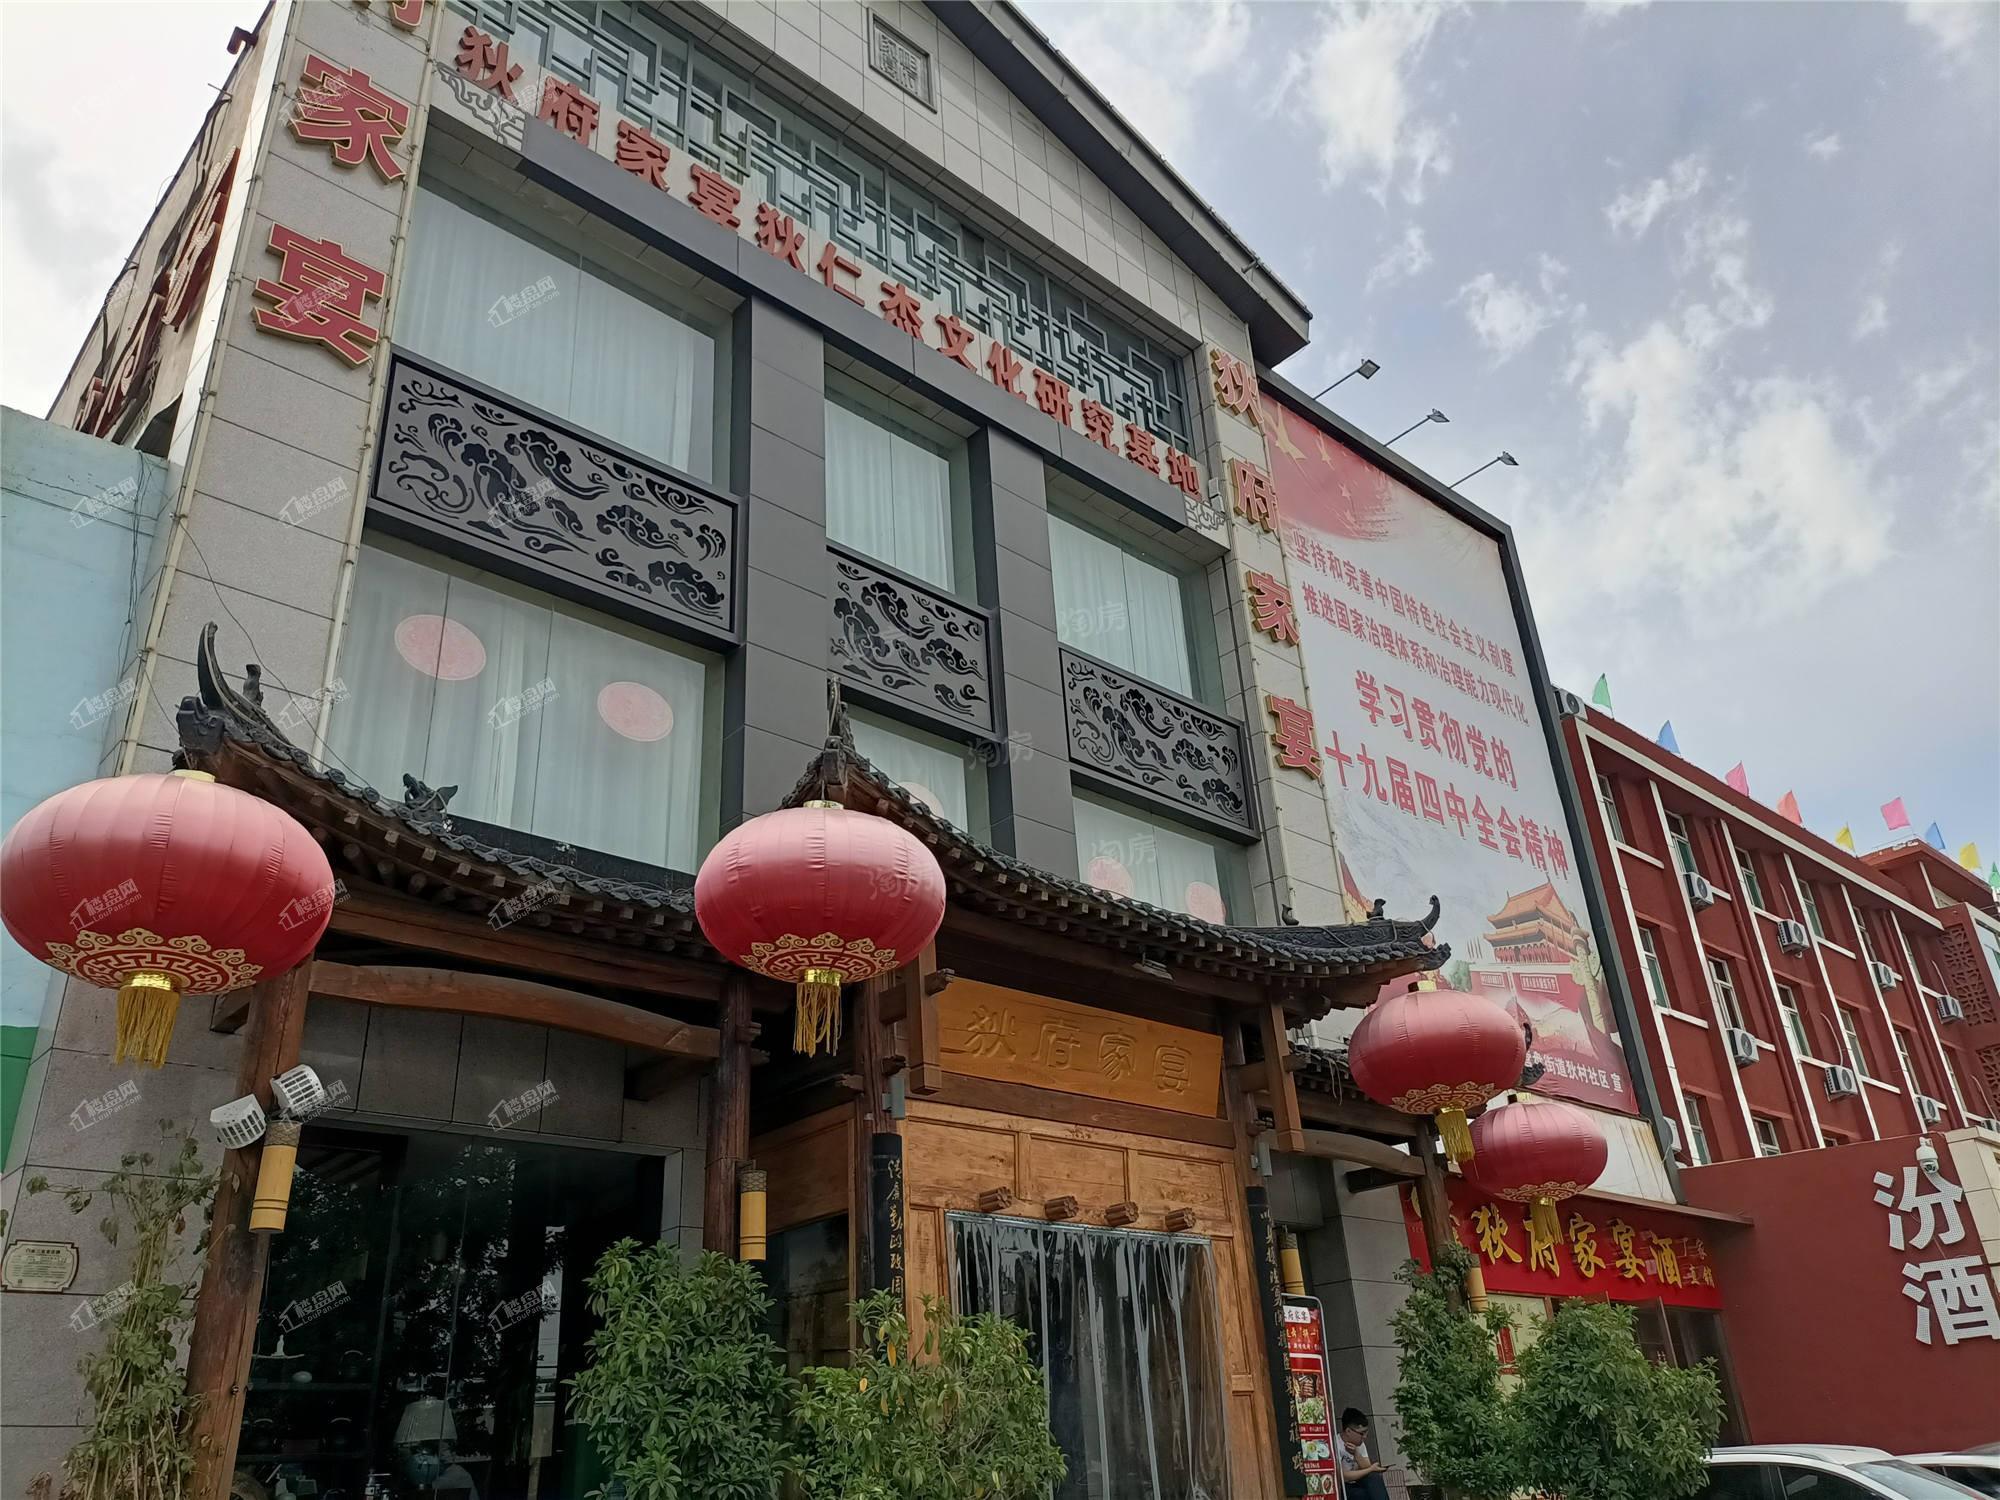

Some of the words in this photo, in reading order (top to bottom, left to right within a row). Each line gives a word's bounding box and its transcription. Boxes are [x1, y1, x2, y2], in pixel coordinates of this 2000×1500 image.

[252, 0, 425, 368] 家宴
[452, 26, 1203, 500] 狄府家宴狄仁杰文化研究基地
[1210, 350, 1324, 782] 狄府家宴
[1291, 529, 1517, 678] 坚持和完善中国特色社会主义制度
[1301, 581, 1529, 727] 推进国家治理体系和治理能力现代化
[1354, 669, 1518, 791] 学习贯彻党的
[1324, 730, 1570, 882] 十九届四中全会精神
[1873, 1165, 2000, 1346] 汾酒
